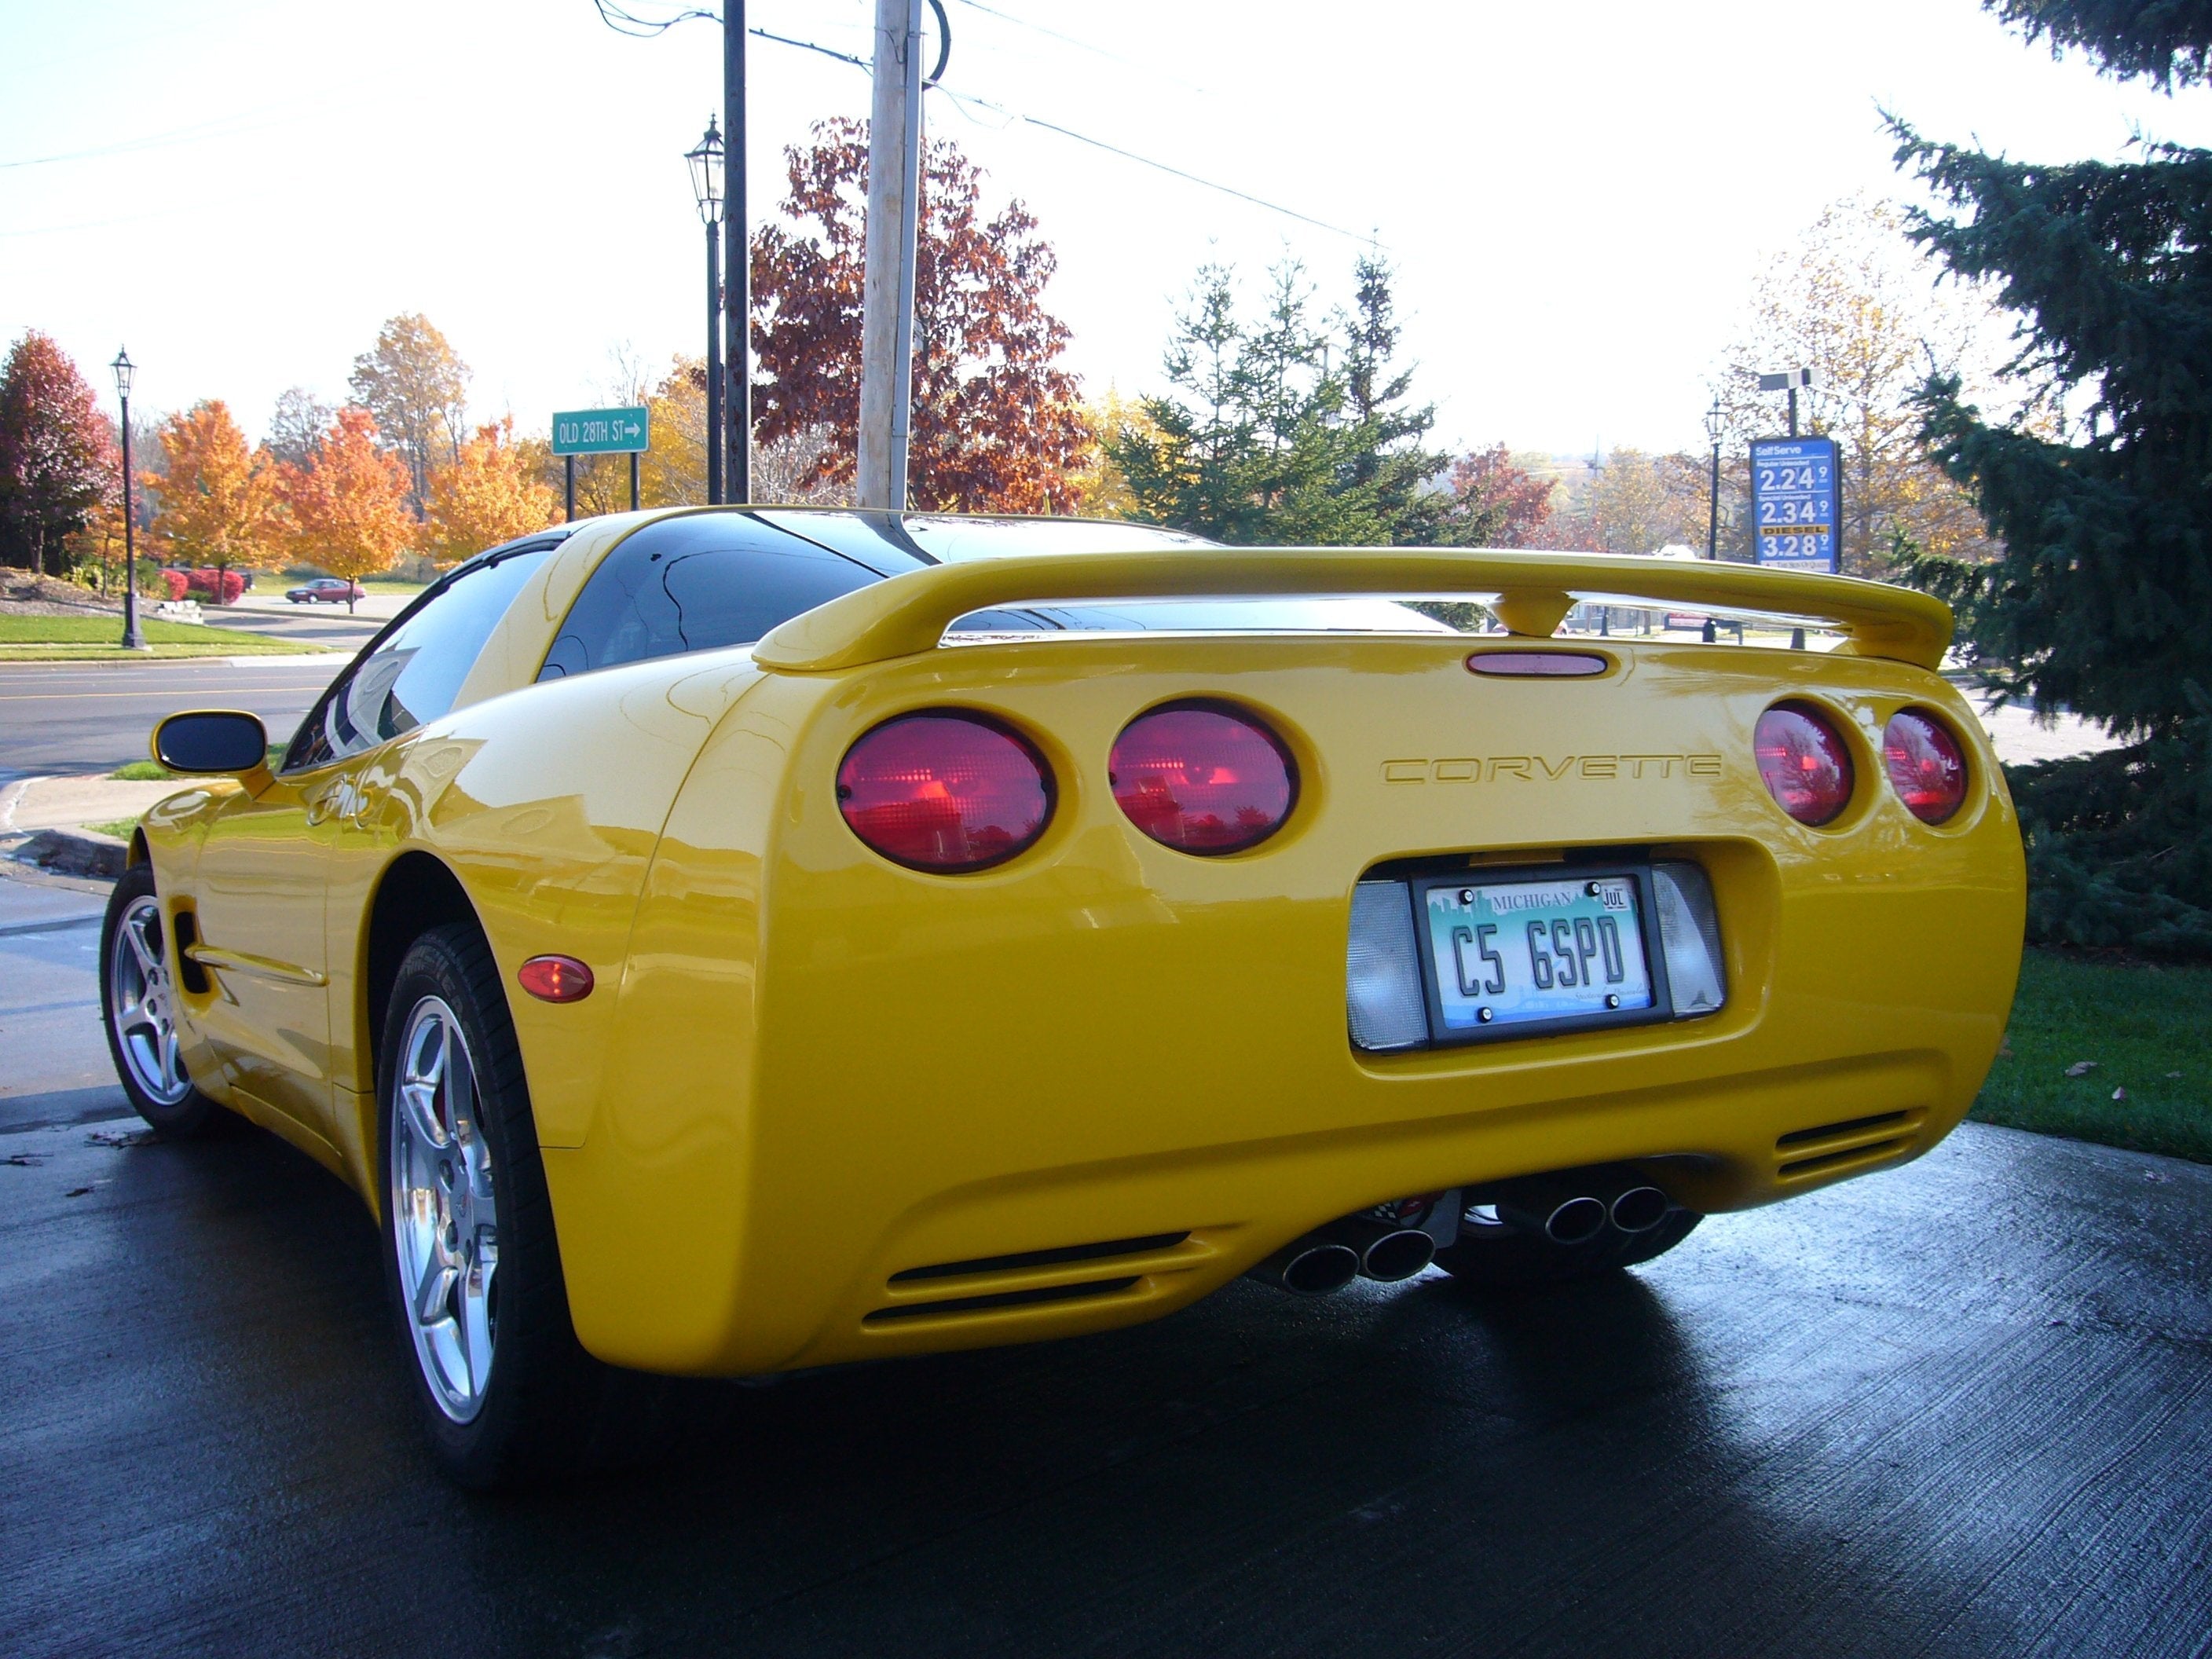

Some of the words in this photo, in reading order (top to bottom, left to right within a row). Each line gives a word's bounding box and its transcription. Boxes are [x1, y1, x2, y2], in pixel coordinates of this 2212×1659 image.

[559, 423, 578, 444] OLD
[583, 421, 608, 443] 28TH
[612, 419, 624, 441] ST
[1760, 467, 1815, 491] 2.24
[1761, 501, 1816, 523] 2.34
[1763, 535, 1816, 557] 3.28
[1379, 754, 1722, 785] CORVETTE
[1493, 892, 1572, 910] MICHIGAN
[1452, 924, 1506, 997] C5
[1527, 916, 1624, 990] 6SPD
